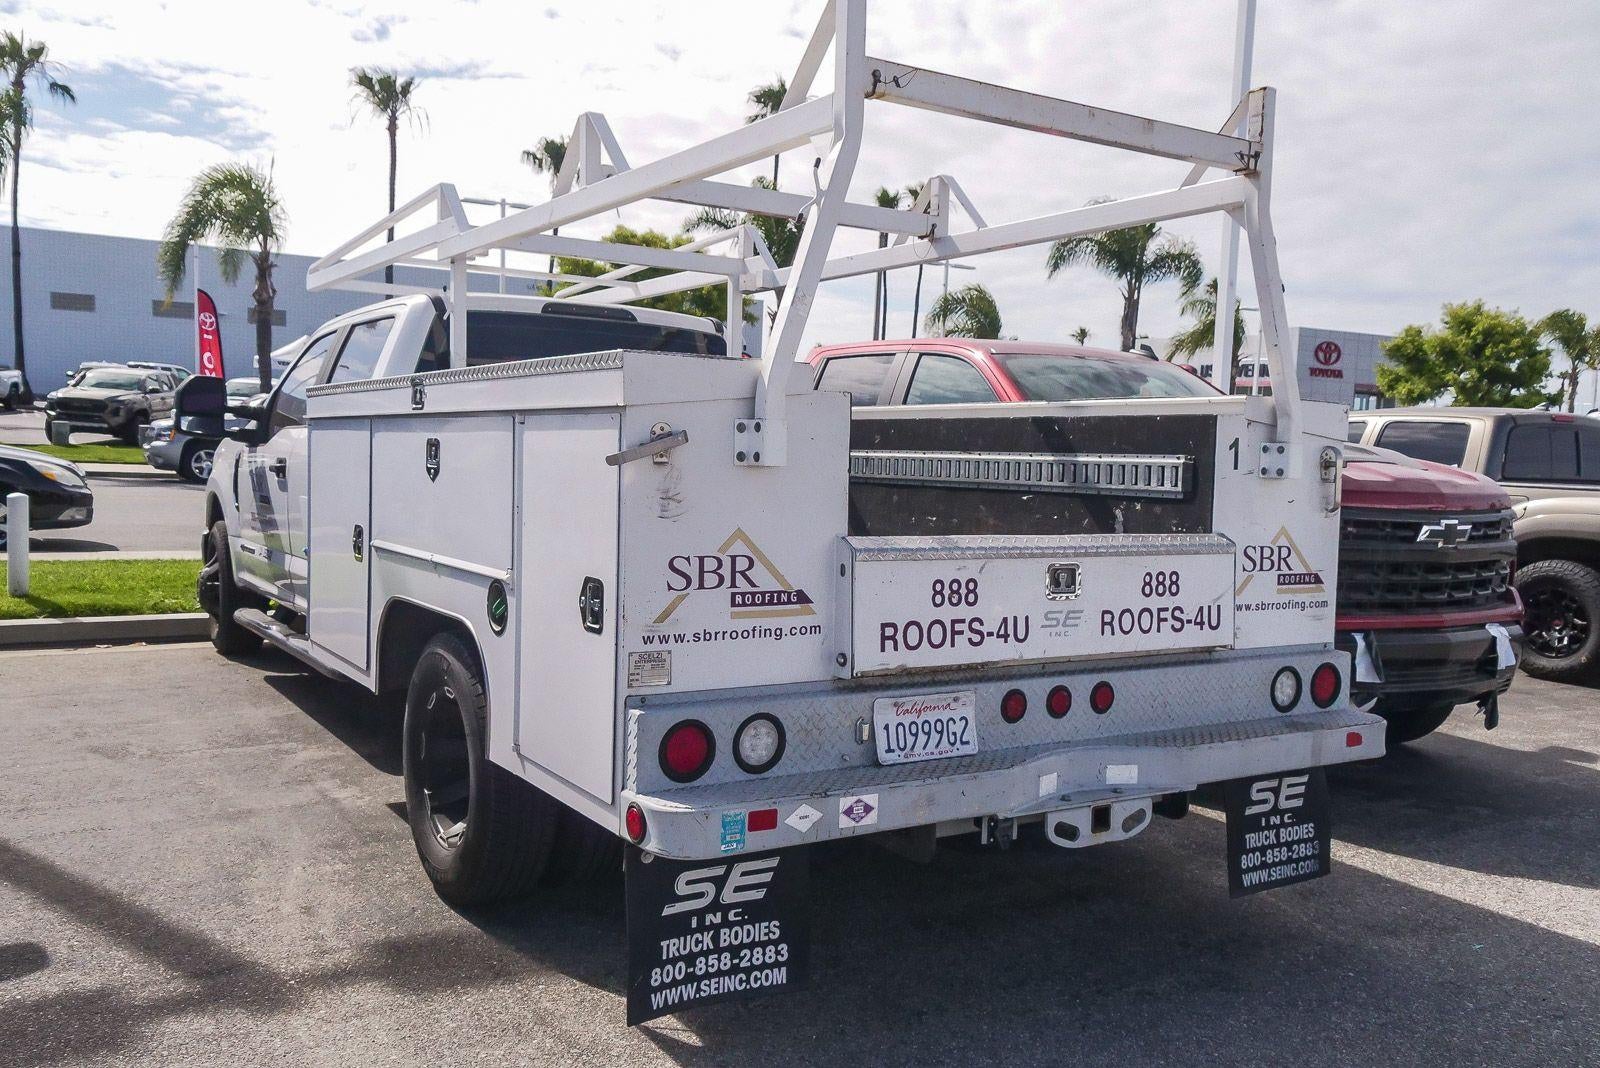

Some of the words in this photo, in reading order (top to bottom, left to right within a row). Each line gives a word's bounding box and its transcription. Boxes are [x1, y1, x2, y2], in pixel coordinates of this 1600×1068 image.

[1308, 367, 1344, 379] TOYOTA
[1229, 437, 1240, 470] 1
[666, 553, 760, 593] SBR
[1242, 545, 1294, 573] SBR
[931, 577, 979, 608] 888
[1141, 570, 1180, 598] 888
[1279, 574, 1315, 584] ROOFING
[735, 592, 798, 605] ROOFING
[1236, 600, 1328, 612] ww.sbrroofing.com
[1040, 609, 1085, 629] SE
[1100, 604, 1222, 637] ROOFS-4U
[642, 625, 821, 645] www.sbrroofing.com
[879, 615, 1030, 653] ROOFS-4U
[895, 700, 957, 719] California
[883, 715, 970, 754] 10999G2
[1244, 774, 1310, 815] SE
[1261, 813, 1296, 827] INC.
[1245, 829, 1277, 849] TRUCK
[1280, 822, 1315, 843] BODIES
[1241, 840, 1320, 870] 800-858-2883
[661, 856, 780, 917] SE
[691, 908, 748, 929] INC.
[660, 930, 715, 960] TRUCK
[719, 920, 781, 948] BODIES
[650, 943, 789, 987] 800-858-2883
[650, 966, 787, 1010] WWW.SEINC.COM
